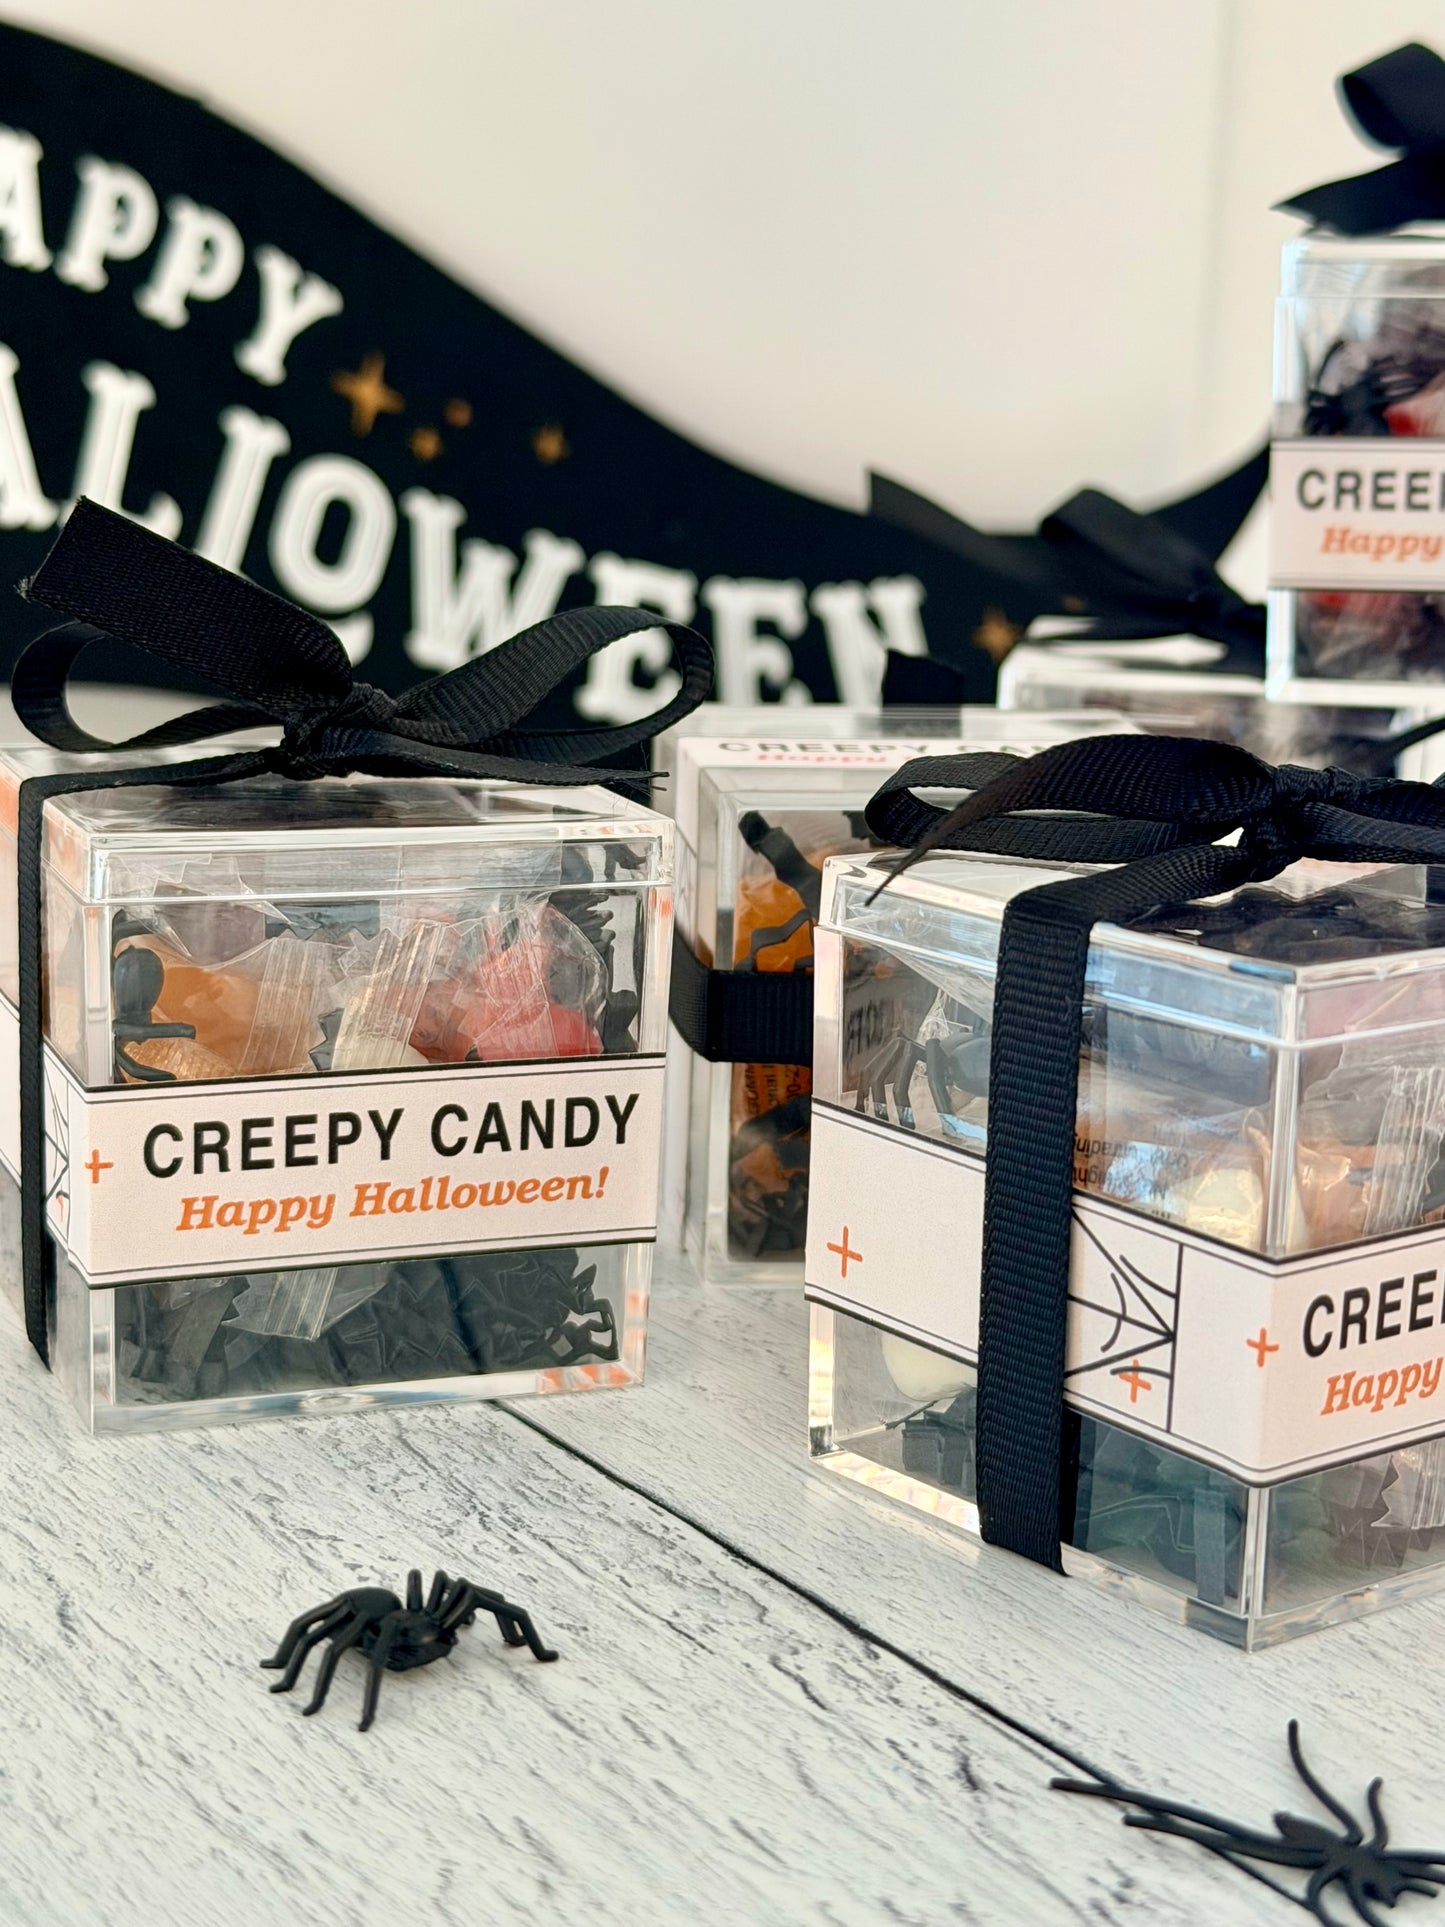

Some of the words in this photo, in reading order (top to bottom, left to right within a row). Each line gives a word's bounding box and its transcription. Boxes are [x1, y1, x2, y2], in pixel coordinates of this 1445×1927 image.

[1297, 469, 1445, 511] CREE
[1320, 527, 1443, 562] Happy
[718, 742, 928, 753] CREEPY
[143, 1108, 404, 1179] CREEPY
[431, 1093, 640, 1155] CANDY
[176, 1191, 335, 1235] Happy
[348, 1167, 609, 1217] Halloween!
[1303, 1268, 1445, 1358] CREE
[1320, 1357, 1443, 1416] Happy
